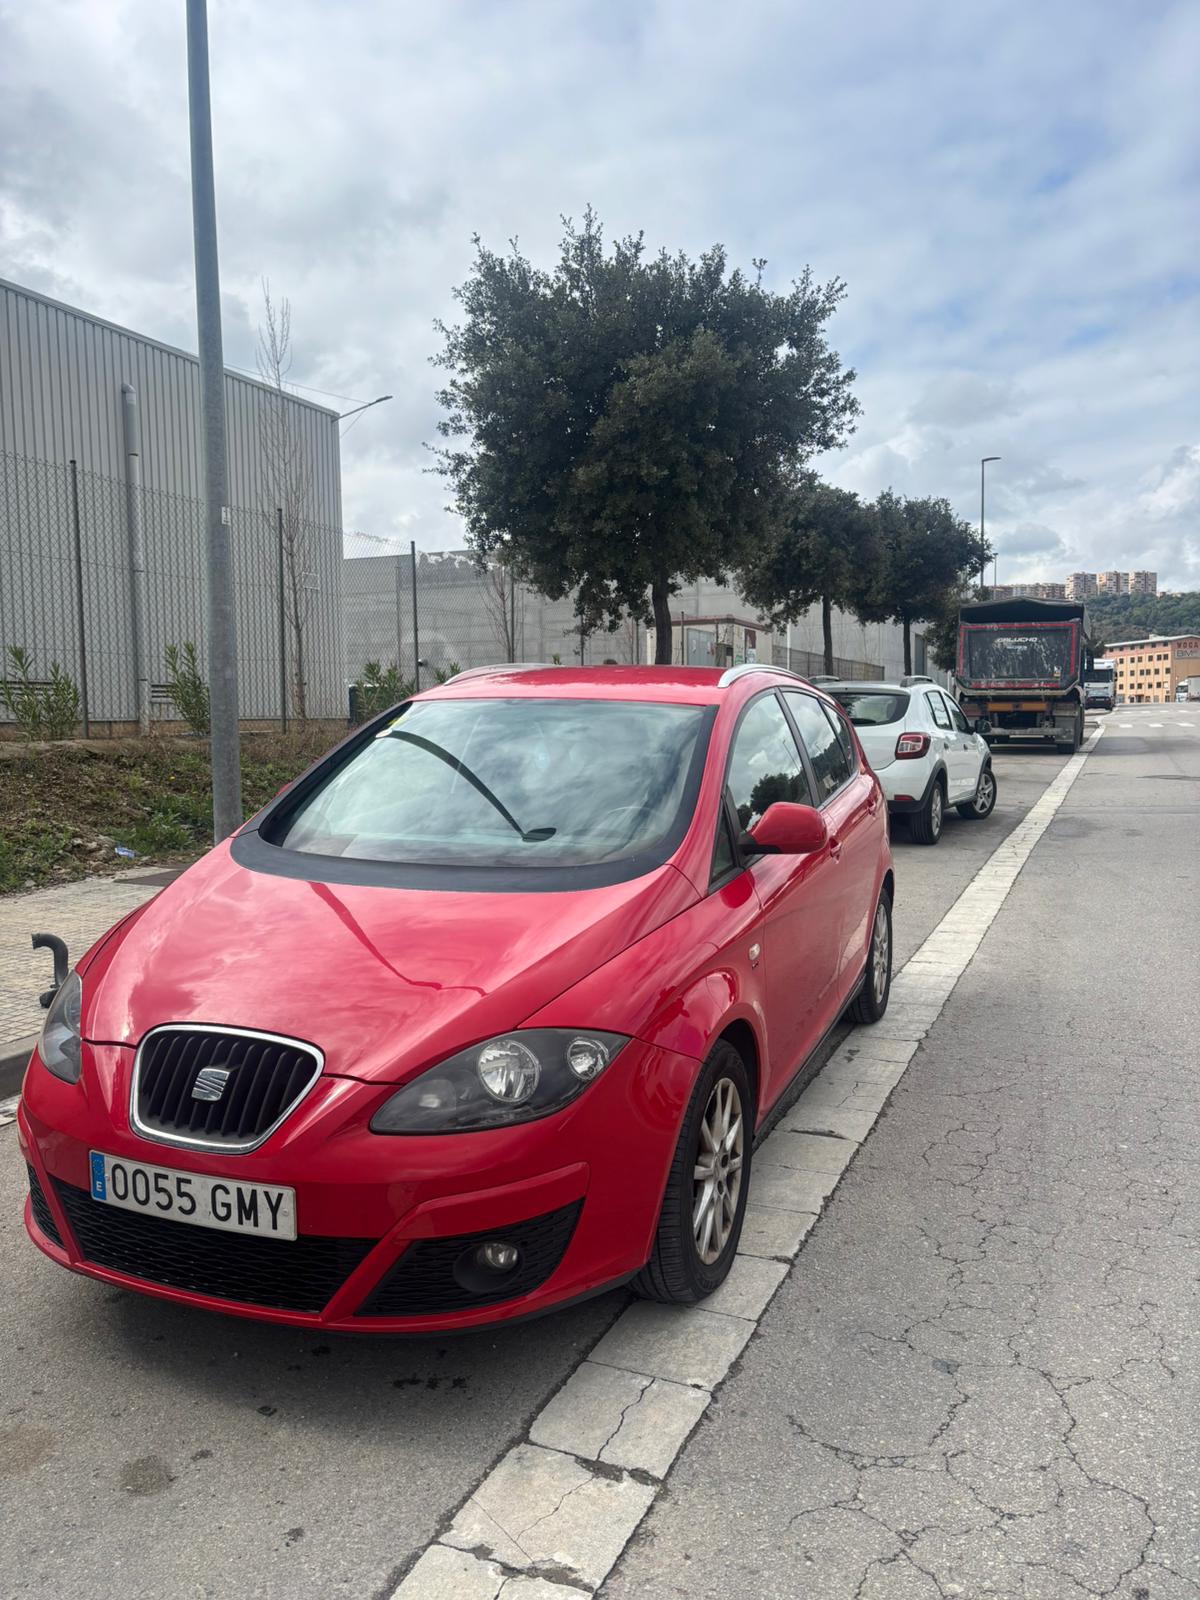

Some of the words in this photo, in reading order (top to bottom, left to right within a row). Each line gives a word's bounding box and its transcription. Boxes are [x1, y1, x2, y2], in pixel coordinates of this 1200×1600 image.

[96, 1181, 103, 1192] E
[111, 1163, 197, 1215] 0055
[210, 1184, 284, 1230] GMY
